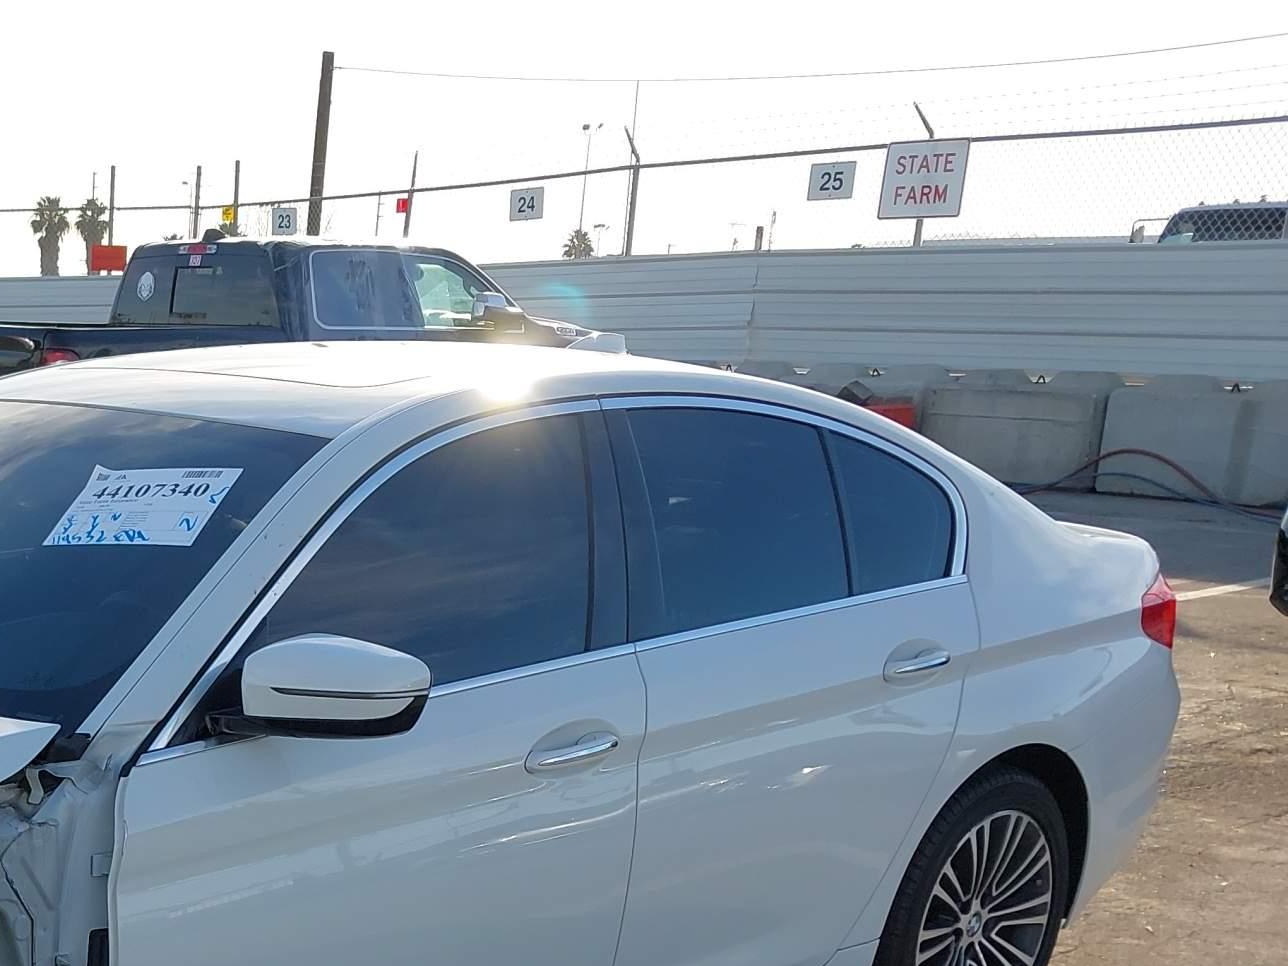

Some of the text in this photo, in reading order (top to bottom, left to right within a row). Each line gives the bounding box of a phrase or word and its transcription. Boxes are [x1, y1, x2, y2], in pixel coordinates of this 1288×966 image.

[895, 153, 956, 175] STATE
[819, 171, 844, 191] 25
[893, 184, 948, 205] FARM
[517, 196, 535, 213] 24
[278, 214, 291, 229] 23
[92, 483, 210, 499] 44107340
